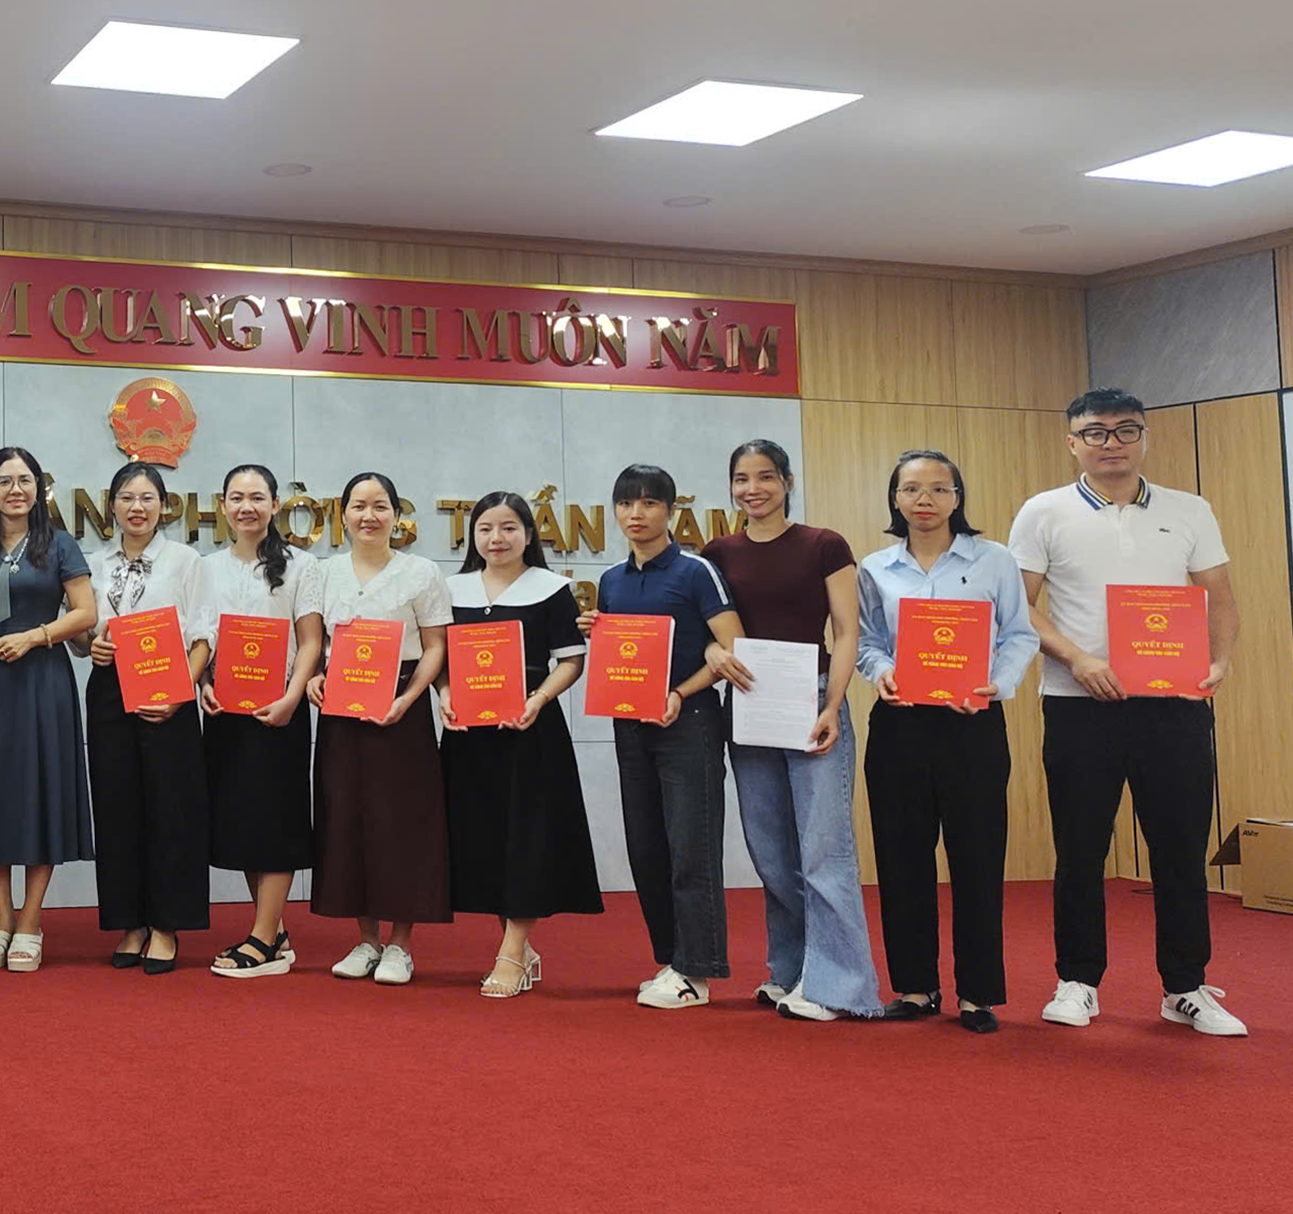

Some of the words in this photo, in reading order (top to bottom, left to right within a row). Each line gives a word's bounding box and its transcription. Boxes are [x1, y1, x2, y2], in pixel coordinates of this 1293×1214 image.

[48, 280, 269, 356] QUANG
[286, 294, 442, 359] VINH
[457, 297, 630, 368] MUÔN
[648, 307, 782, 376] NĂM
